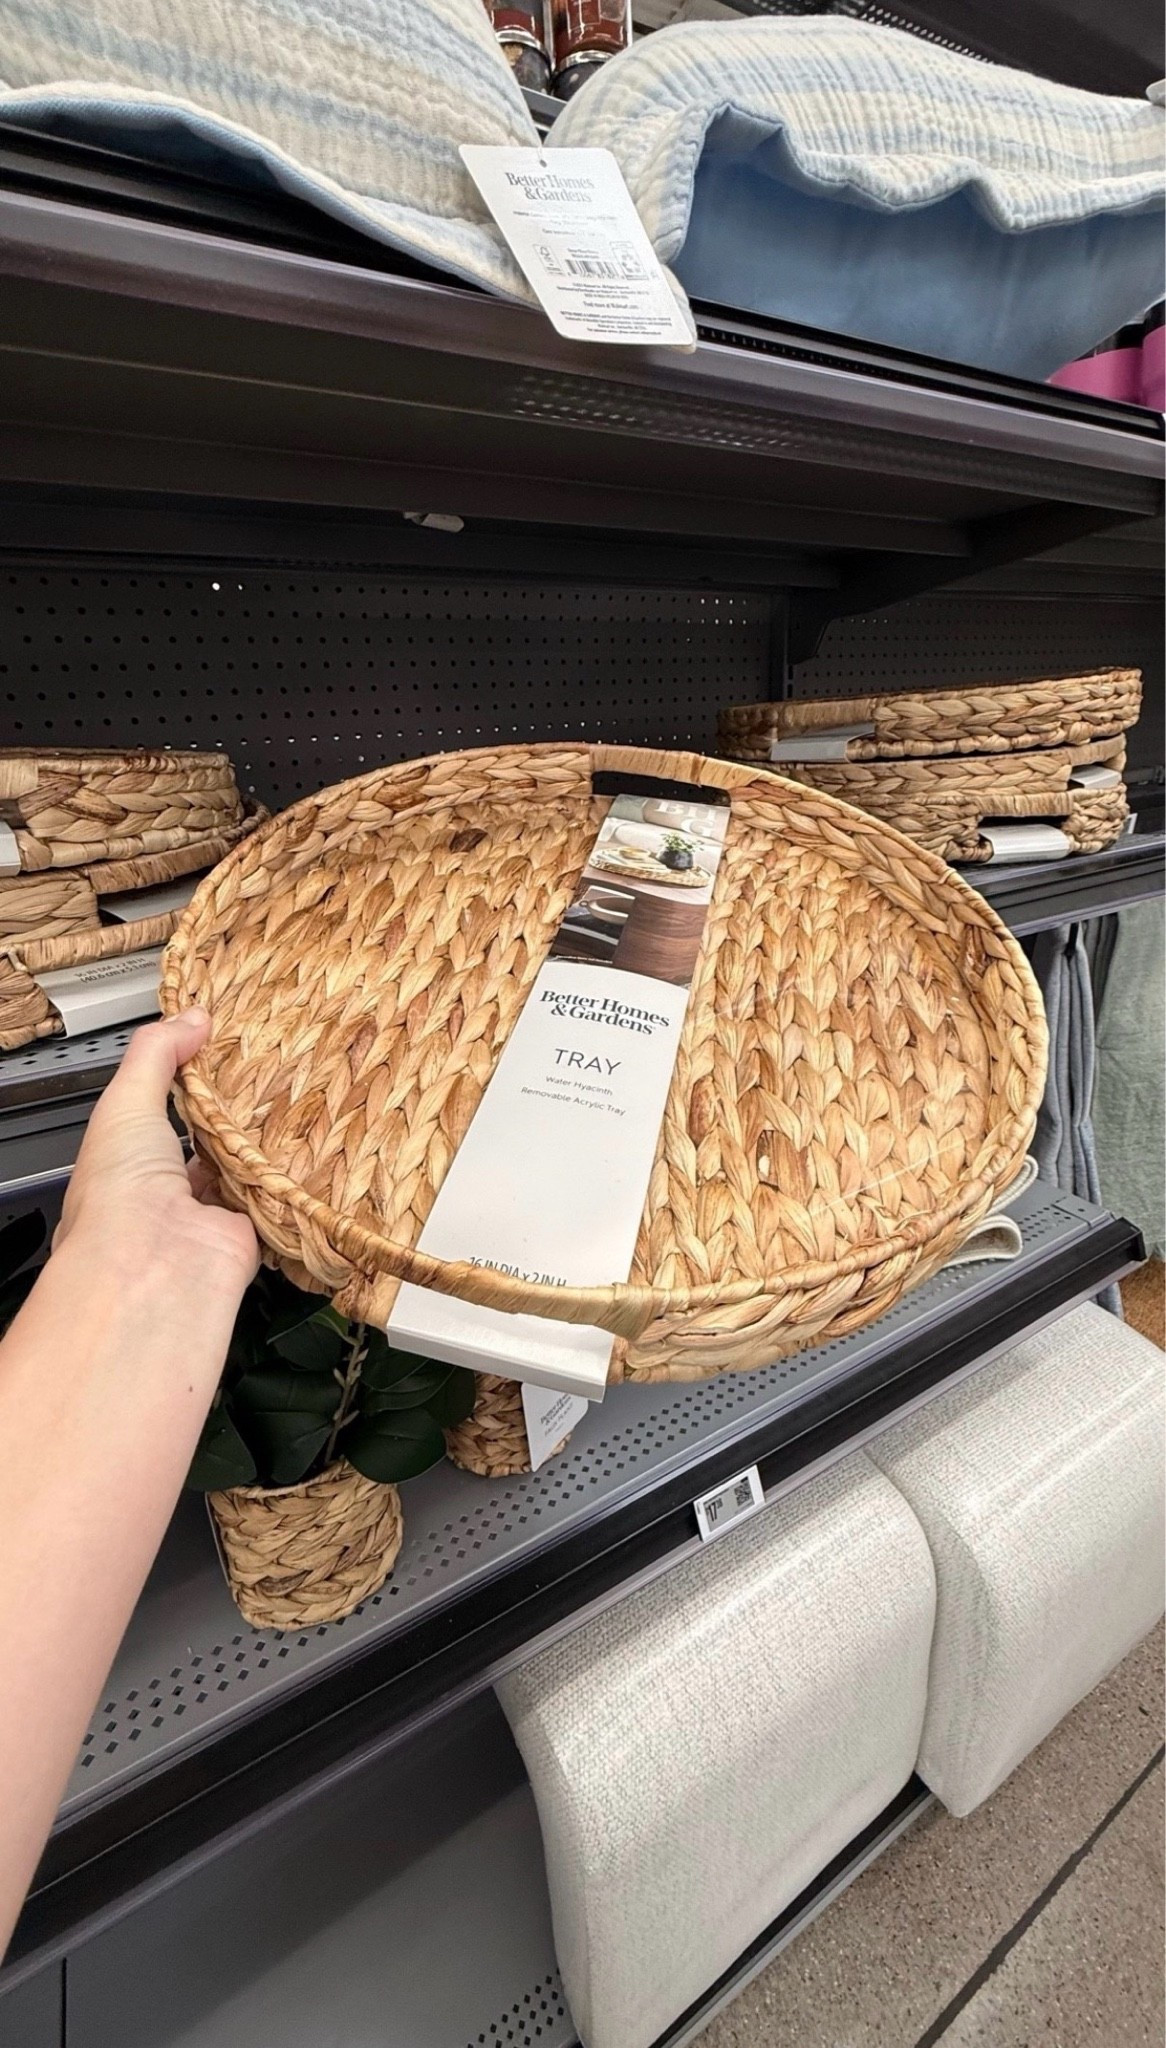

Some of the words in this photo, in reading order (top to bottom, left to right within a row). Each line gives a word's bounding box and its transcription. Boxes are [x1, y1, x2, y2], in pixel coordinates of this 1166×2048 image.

[505, 172, 546, 187] Better
[546, 174, 594, 189] Homes
[540, 990, 600, 1008] Better
[600, 998, 670, 1027] Homes
[555, 1048, 622, 1075] TRAY
[545, 1076, 572, 1086] Water
[573, 1082, 613, 1097] Hyacinth
[520, 1086, 572, 1102] Removable
[573, 1097, 605, 1110] Acrylic
[607, 1104, 626, 1117] Tray
[469, 1256, 483, 1268] 16
[533, 1271, 540, 1284] 2
[541, 1273, 555, 1286] IN
